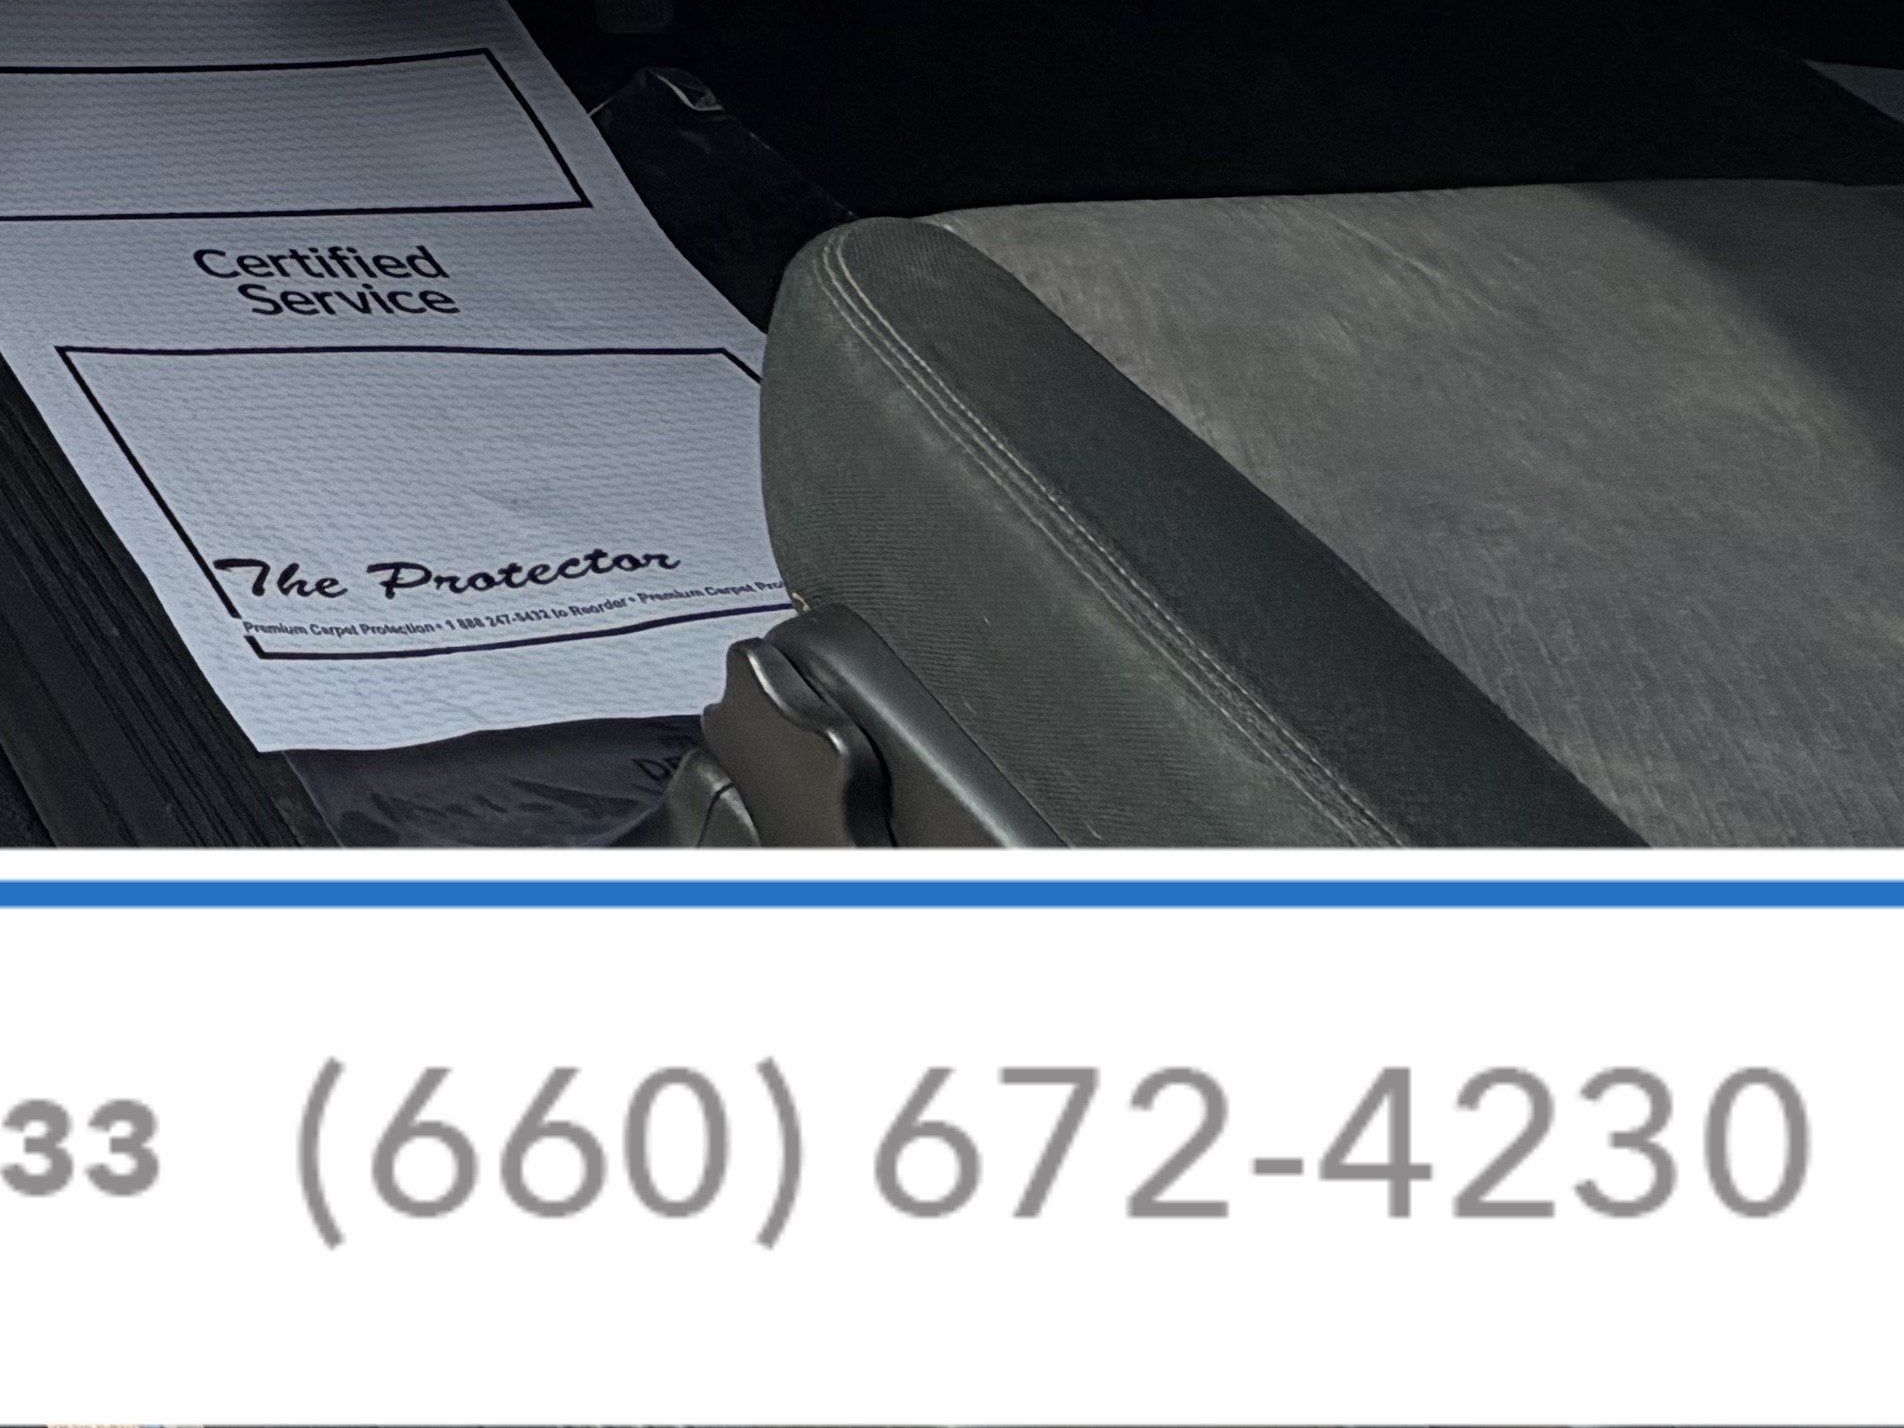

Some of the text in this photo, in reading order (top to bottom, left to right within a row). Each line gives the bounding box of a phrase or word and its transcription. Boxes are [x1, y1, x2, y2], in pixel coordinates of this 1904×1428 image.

[193, 245, 450, 279] Certified
[237, 282, 461, 316] Service
[213, 548, 681, 600] The Protector
[242, 620, 309, 635] Premium
[309, 623, 360, 639] Carpet
[551, 608, 569, 620] to
[568, 597, 628, 617] Reorder
[704, 584, 757, 596] Carpet
